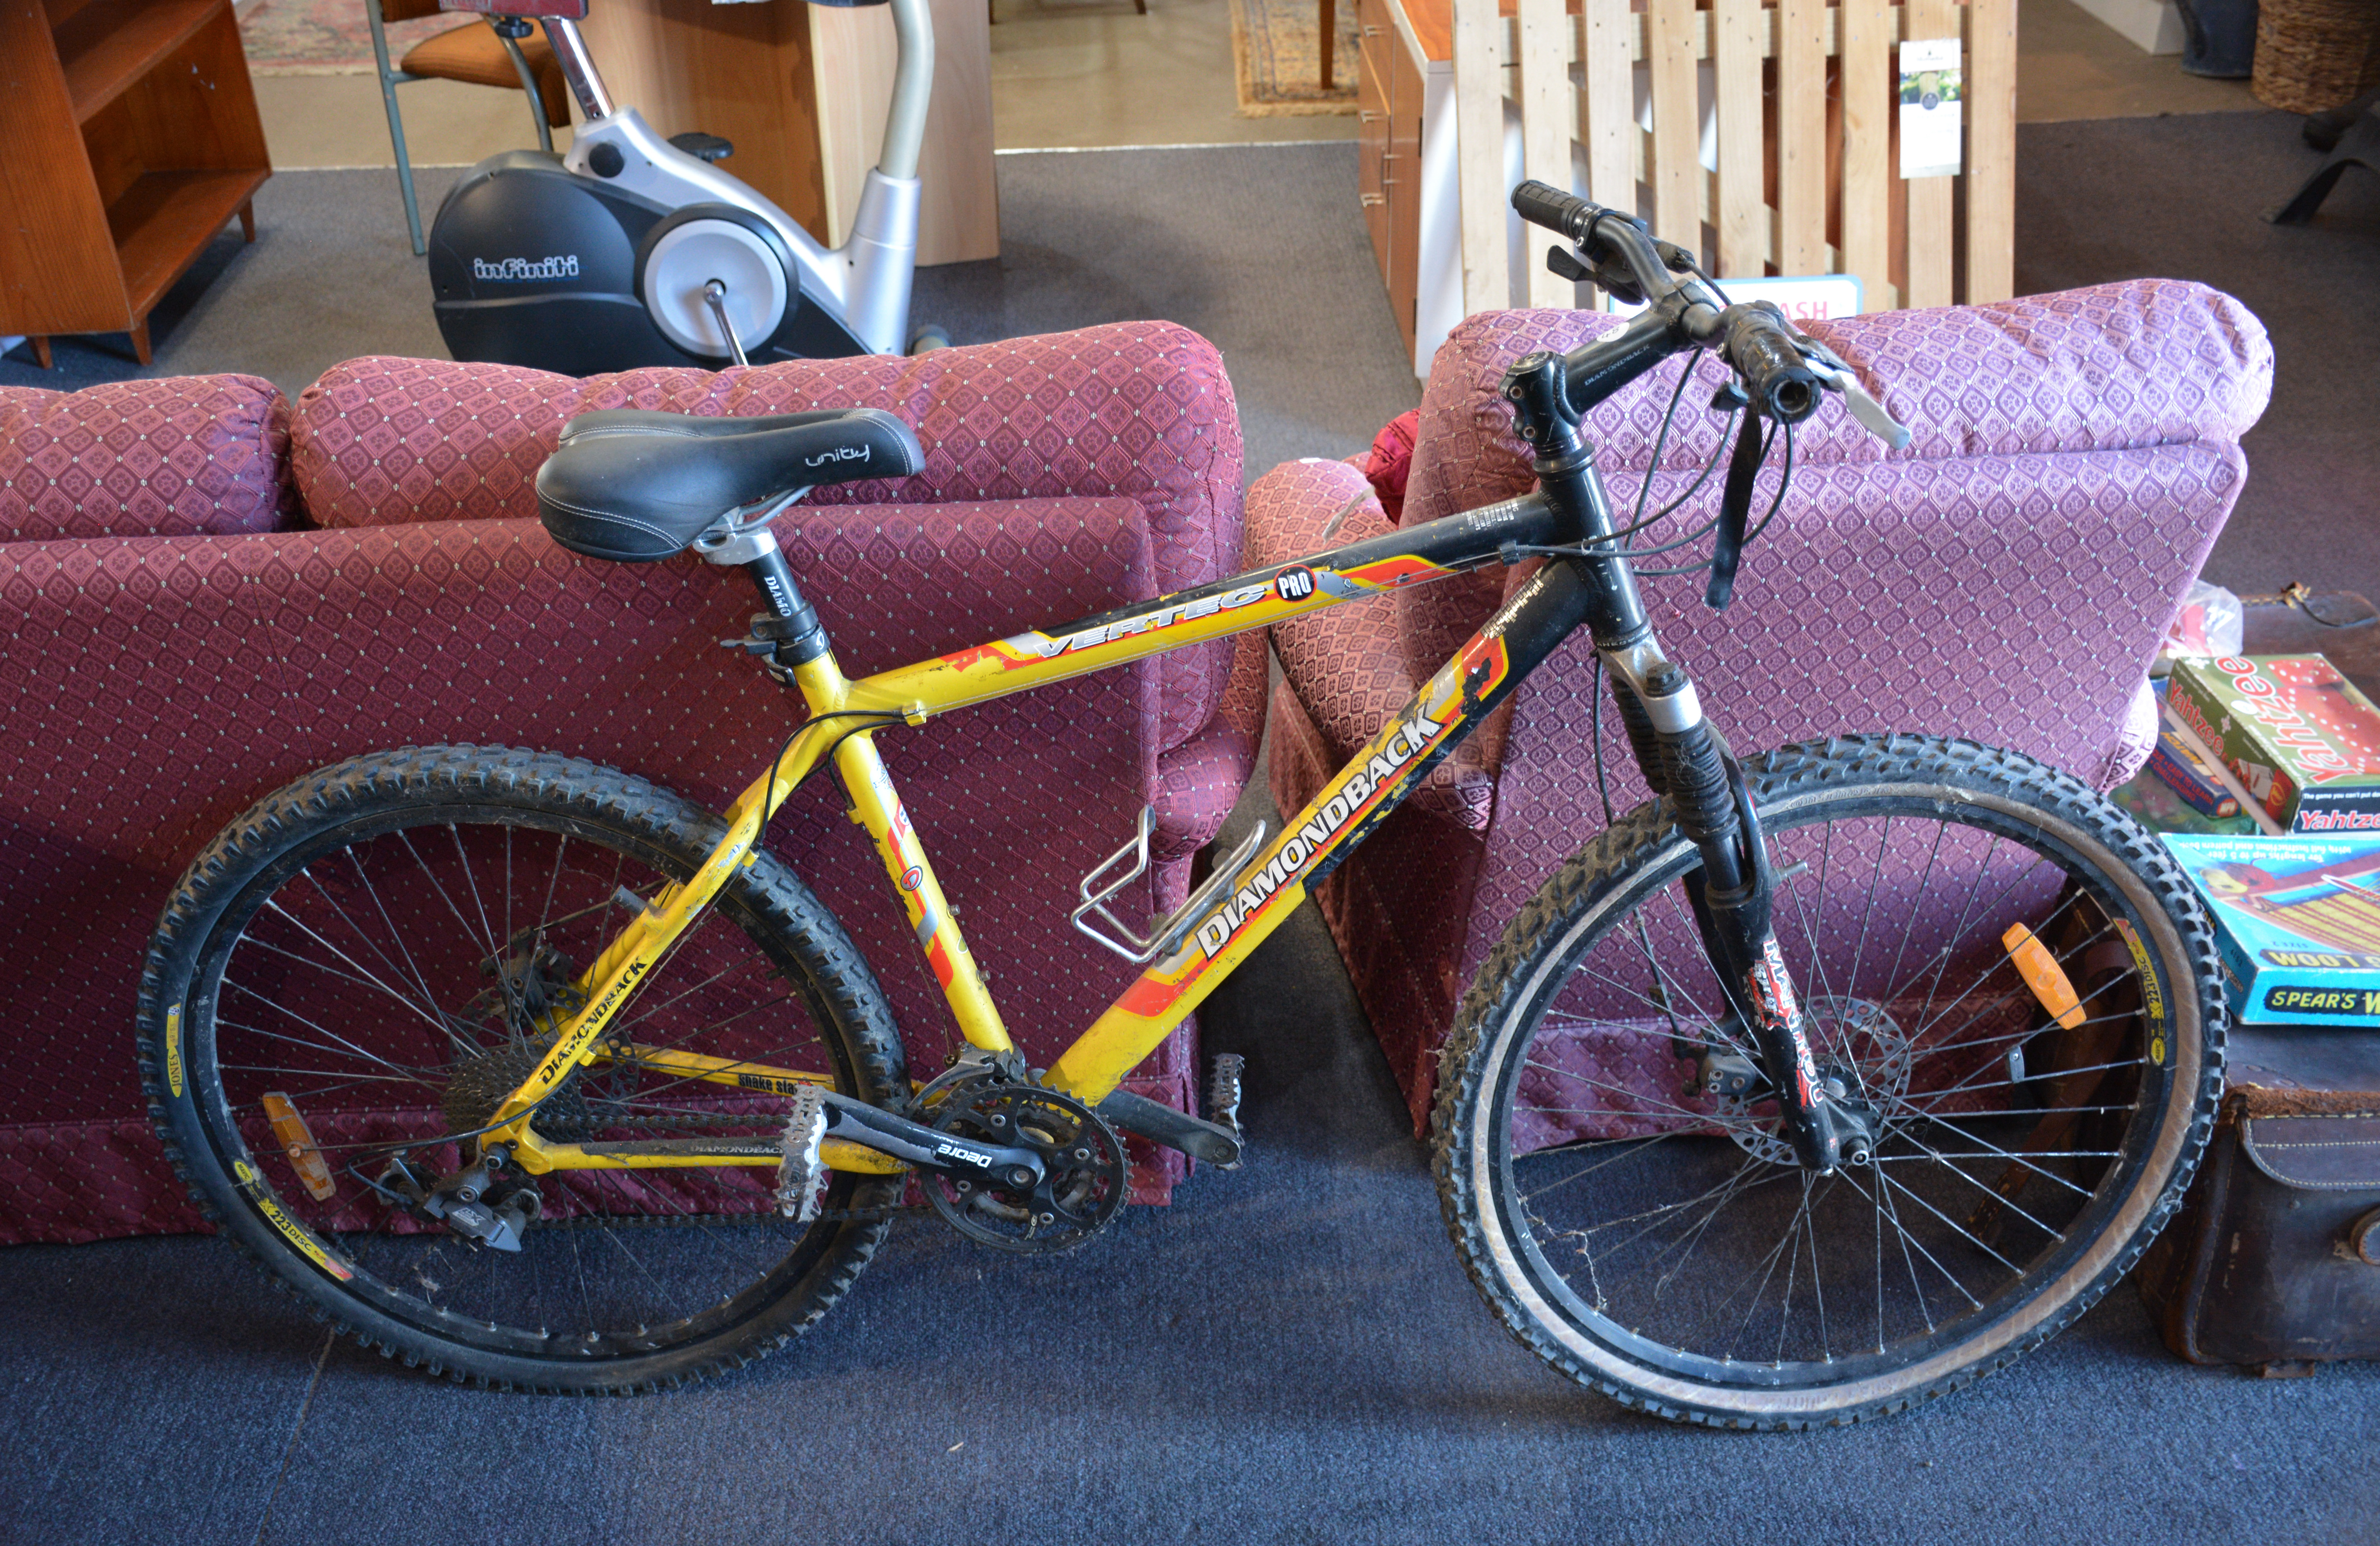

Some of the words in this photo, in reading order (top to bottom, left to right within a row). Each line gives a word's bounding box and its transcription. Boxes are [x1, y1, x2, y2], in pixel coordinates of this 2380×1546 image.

[474, 255, 579, 279] infiniti
[805, 445, 870, 467] unity
[1034, 584, 1266, 657] VERTEC
[1278, 572, 1312, 599] PRO
[2169, 675, 2224, 756] Yahtzee
[2215, 656, 2365, 785] Yahtzee
[2184, 776, 2193, 787] TO
[1197, 706, 1445, 959] DIAMONDBACK
[2268, 951, 2360, 968] LOOM
[2272, 991, 2357, 1010] SPEAR'S
[169, 1054, 182, 1087] JONES
[776, 1079, 798, 1095] sta
[238, 1163, 250, 1180] MAVIC
[288, 1228, 313, 1252] DISC
